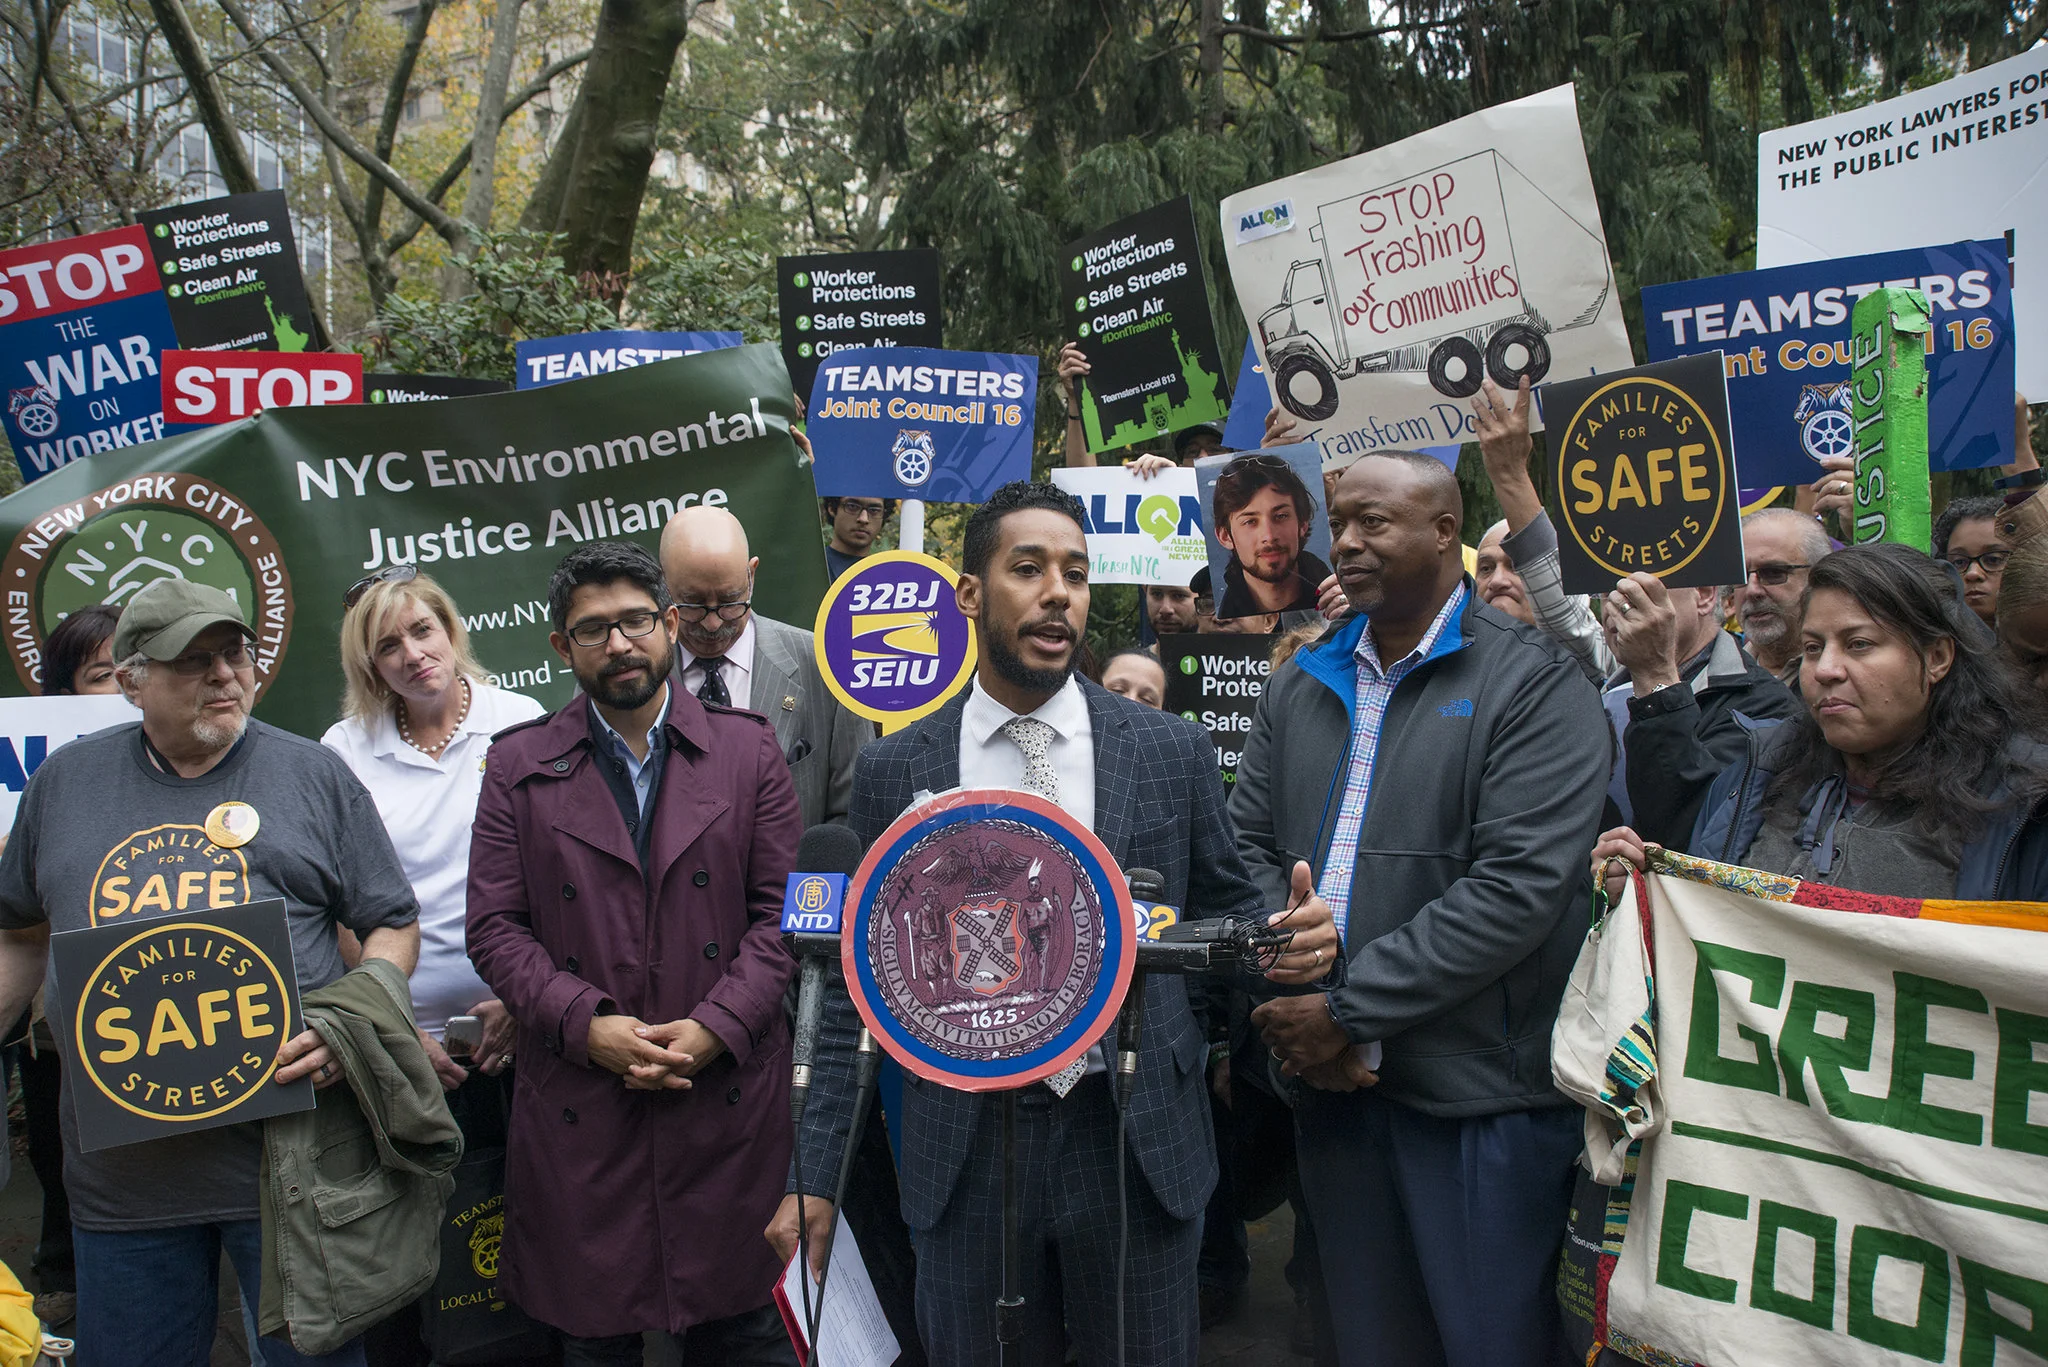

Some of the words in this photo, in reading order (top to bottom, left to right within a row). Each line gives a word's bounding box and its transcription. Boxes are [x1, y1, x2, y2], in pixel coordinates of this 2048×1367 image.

[1778, 140, 1827, 165] NEW
[1834, 121, 1894, 151] YORK
[1901, 87, 2000, 135] LAWYERS
[1778, 167, 1821, 191] THE
[1834, 140, 1920, 179] PUBLIC
[1360, 172, 1455, 234] STOP
[169, 213, 230, 234] Worker
[174, 220, 269, 249] Protections
[179, 254, 218, 272] Safe
[221, 241, 282, 262] Streets
[1084, 233, 1136, 265] Worker
[1086, 237, 1175, 282] Protections
[1343, 215, 1486, 283] Trashing
[184, 275, 231, 295] Clean
[236, 268, 258, 284] Air
[811, 270, 876, 287] Worker
[812, 284, 916, 303] Protections
[1088, 283, 1125, 308] Safe
[1128, 261, 1187, 293] Streets
[814, 312, 855, 331] Safe
[860, 311, 926, 328] Streets
[1093, 307, 1138, 334] Clean
[1143, 296, 1164, 318] Air
[1343, 283, 1376, 327] our
[1662, 270, 1992, 346] TEAMSRS
[55, 316, 98, 342] THE
[1947, 318, 1993, 352] 16
[24, 334, 159, 400] WAR
[825, 366, 1024, 399] TEAMSTERS
[174, 366, 353, 416] STOP
[1101, 383, 1140, 404] Teamsters
[1140, 378, 1161, 392] Local
[1161, 373, 1176, 386] 813
[89, 396, 121, 421] ON
[818, 396, 881, 418] Joint
[888, 397, 984, 424] Council
[993, 403, 1022, 426] 16
[1576, 391, 1692, 453] FAMILIES
[297, 452, 414, 501] NYC
[422, 398, 768, 489] Environmental
[1619, 426, 1646, 440] FOR
[1571, 443, 1711, 514] SAFE
[20, 504, 85, 560] NEW
[93, 476, 176, 509] YORK
[185, 484, 253, 531] CITY
[363, 517, 532, 570] Justice
[1590, 514, 1700, 565] STREETS
[256, 552, 286, 674] ALLIANCE
[849, 581, 940, 611] 32BJ
[850, 659, 940, 689] SEIU
[1201, 711, 1252, 732] Safe
[113, 833, 230, 871] FAMILIES
[158, 855, 185, 866] FOR
[98, 870, 237, 918] SAFE
[786, 913, 833, 929] NTD
[1147, 906, 1176, 940] 2
[101, 937, 253, 999] FAMILIES
[161, 970, 197, 985] FOR
[95, 982, 275, 1064] SAFE
[971, 1008, 1018, 1029] 1625
[1025, 997, 1068, 1036] NOVI
[121, 1051, 262, 1108] STREETS
[440, 1291, 486, 1311] LOCAL
